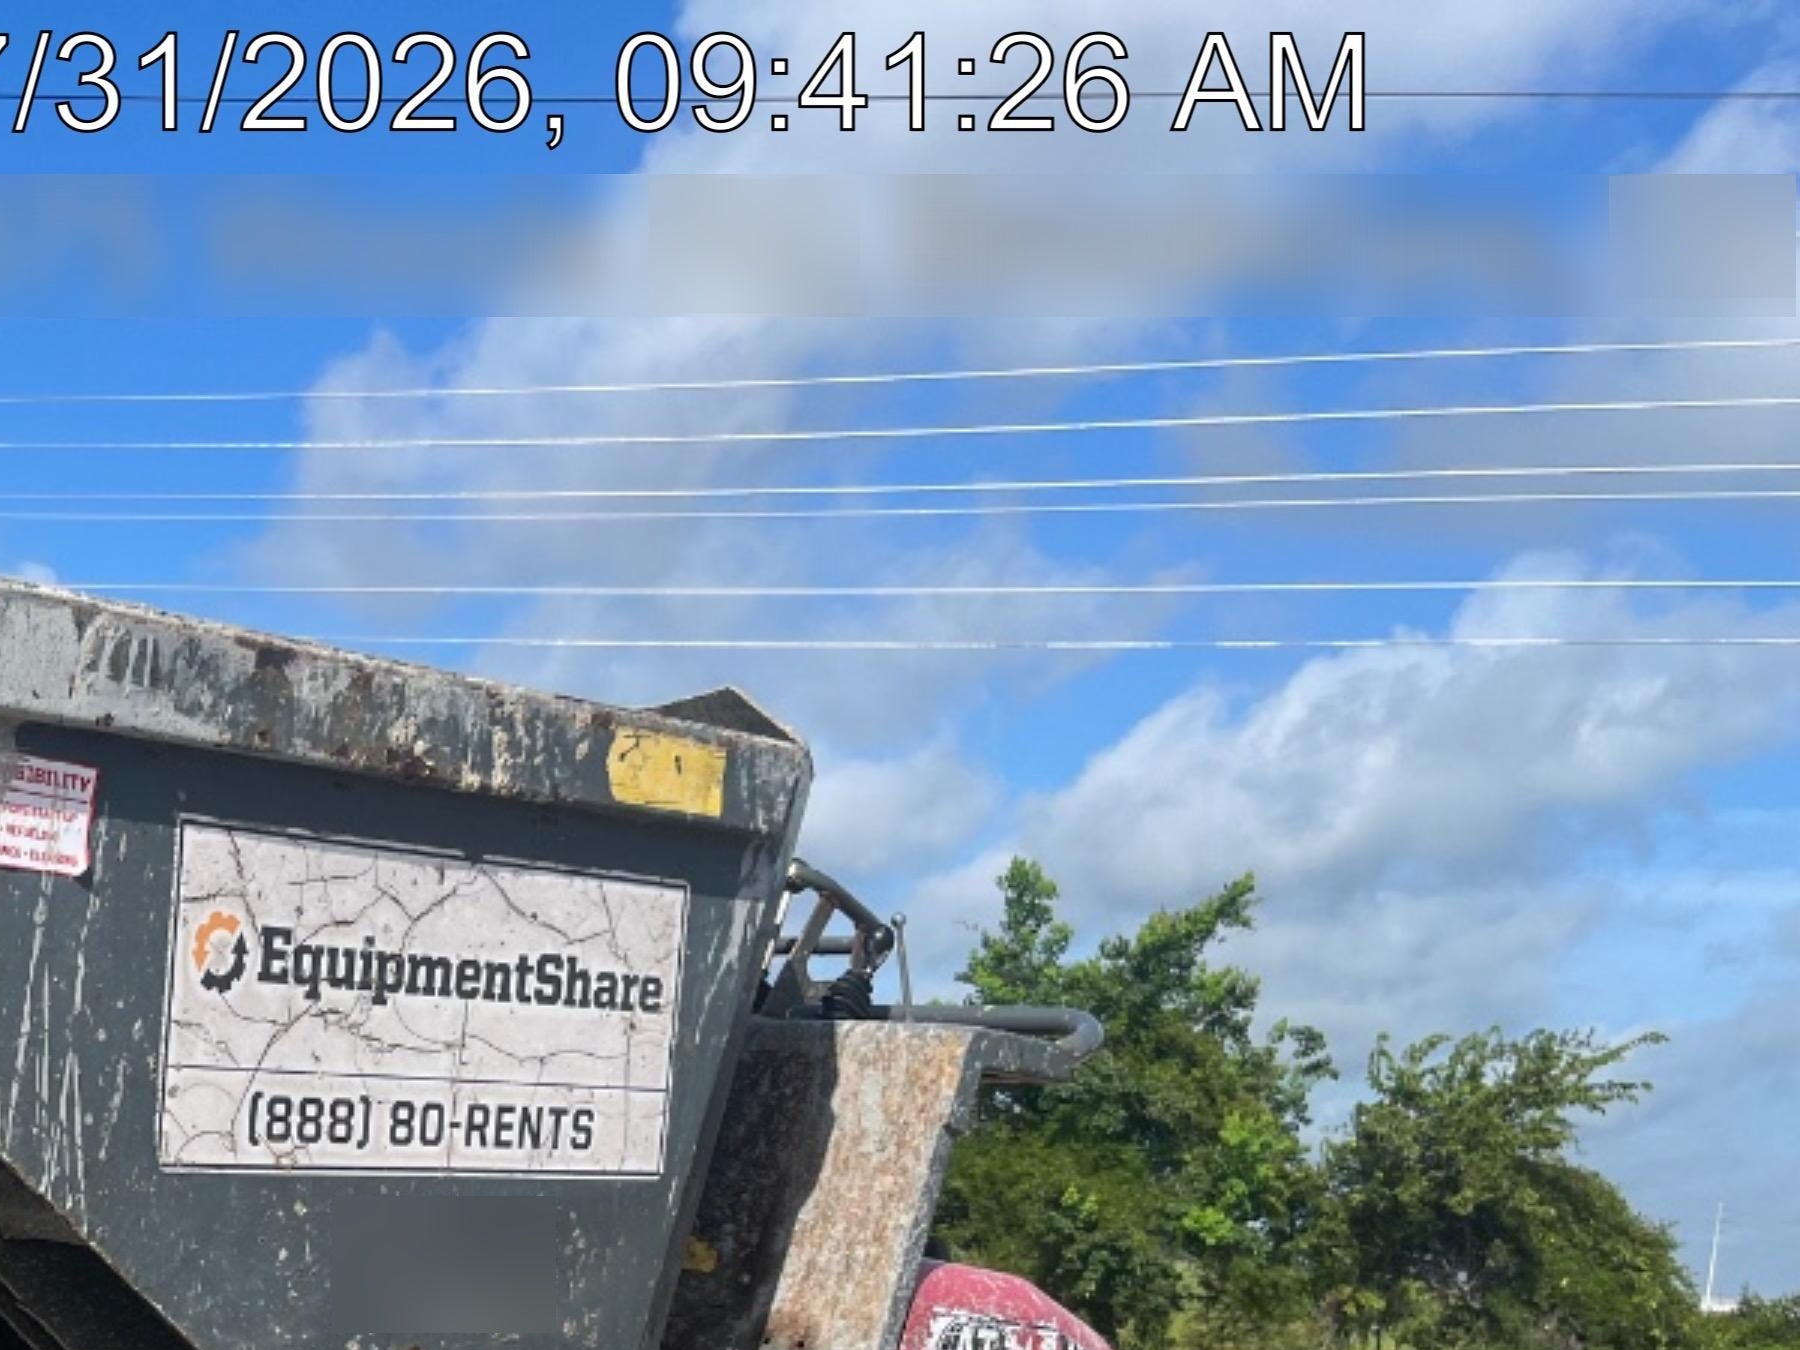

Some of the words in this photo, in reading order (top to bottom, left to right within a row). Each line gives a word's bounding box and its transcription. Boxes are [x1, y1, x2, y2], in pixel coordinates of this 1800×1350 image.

[257, 924, 664, 1014] EquipmentShare
[247, 1091, 371, 1150] (888)
[388, 1100, 595, 1151] 80-RENTS
